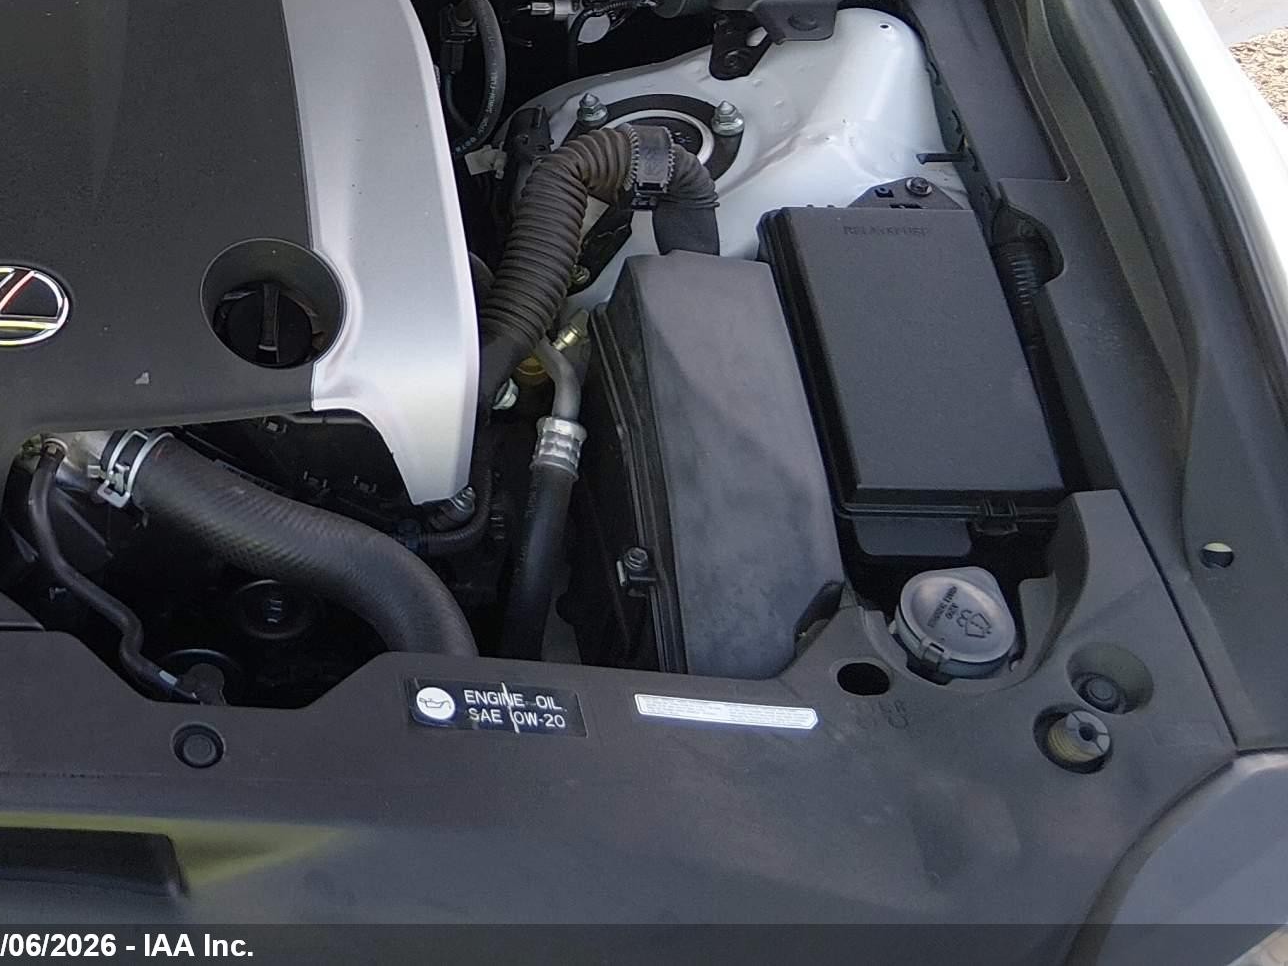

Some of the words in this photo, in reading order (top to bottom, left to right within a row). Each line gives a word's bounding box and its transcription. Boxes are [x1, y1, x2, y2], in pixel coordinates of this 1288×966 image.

[464, 689, 525, 708] ENGINE
[535, 695, 562, 710] OIL
[468, 708, 503, 723] SAE
[513, 711, 566, 728] 0W-20
